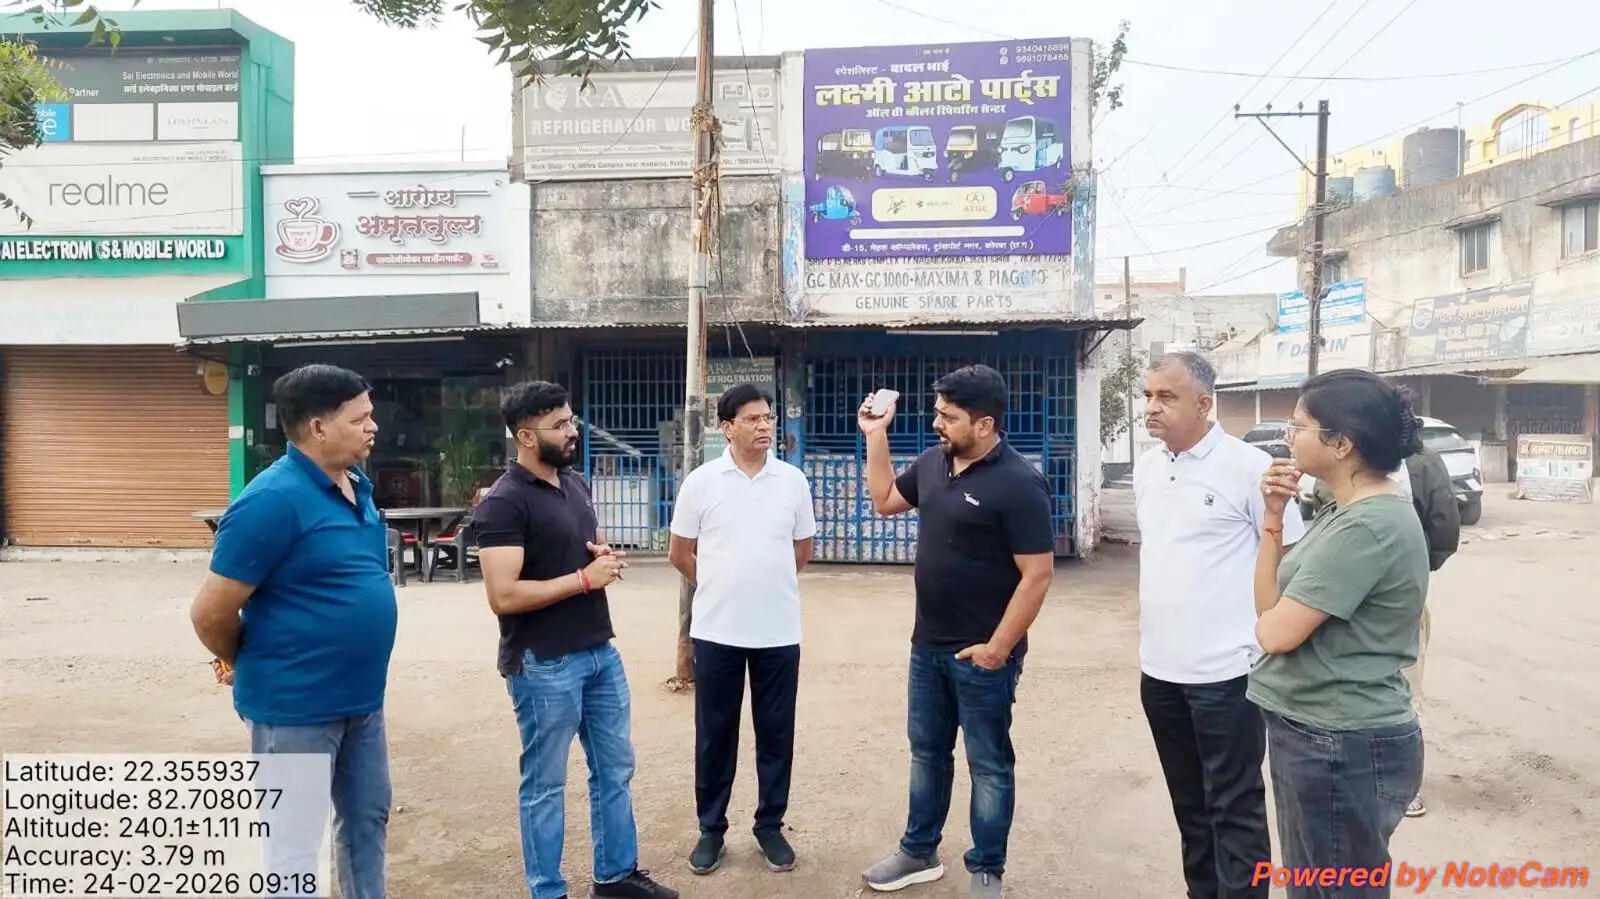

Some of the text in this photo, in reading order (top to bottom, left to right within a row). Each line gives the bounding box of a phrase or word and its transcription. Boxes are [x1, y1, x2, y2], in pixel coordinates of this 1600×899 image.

[135, 71, 176, 81] Electronics
[177, 71, 191, 80] and
[192, 70, 216, 80] Mobile
[217, 70, 239, 79] World
[69, 87, 101, 97] Partner
[530, 117, 657, 136] REFRIGERATOR
[49, 174, 169, 206] realme
[384, 184, 458, 209] आरोग्य
[356, 214, 483, 245] अमृततुल्य
[123, 239, 173, 260] MOBILE
[174, 239, 226, 259] WORLD
[806, 272, 825, 288] GC
[973, 268, 983, 285] &
[855, 294, 1013, 310] GENUINE SPARE PARTS
[1290, 338, 1348, 357] DAIN
[706, 373, 773, 385] EFRIGERATION
